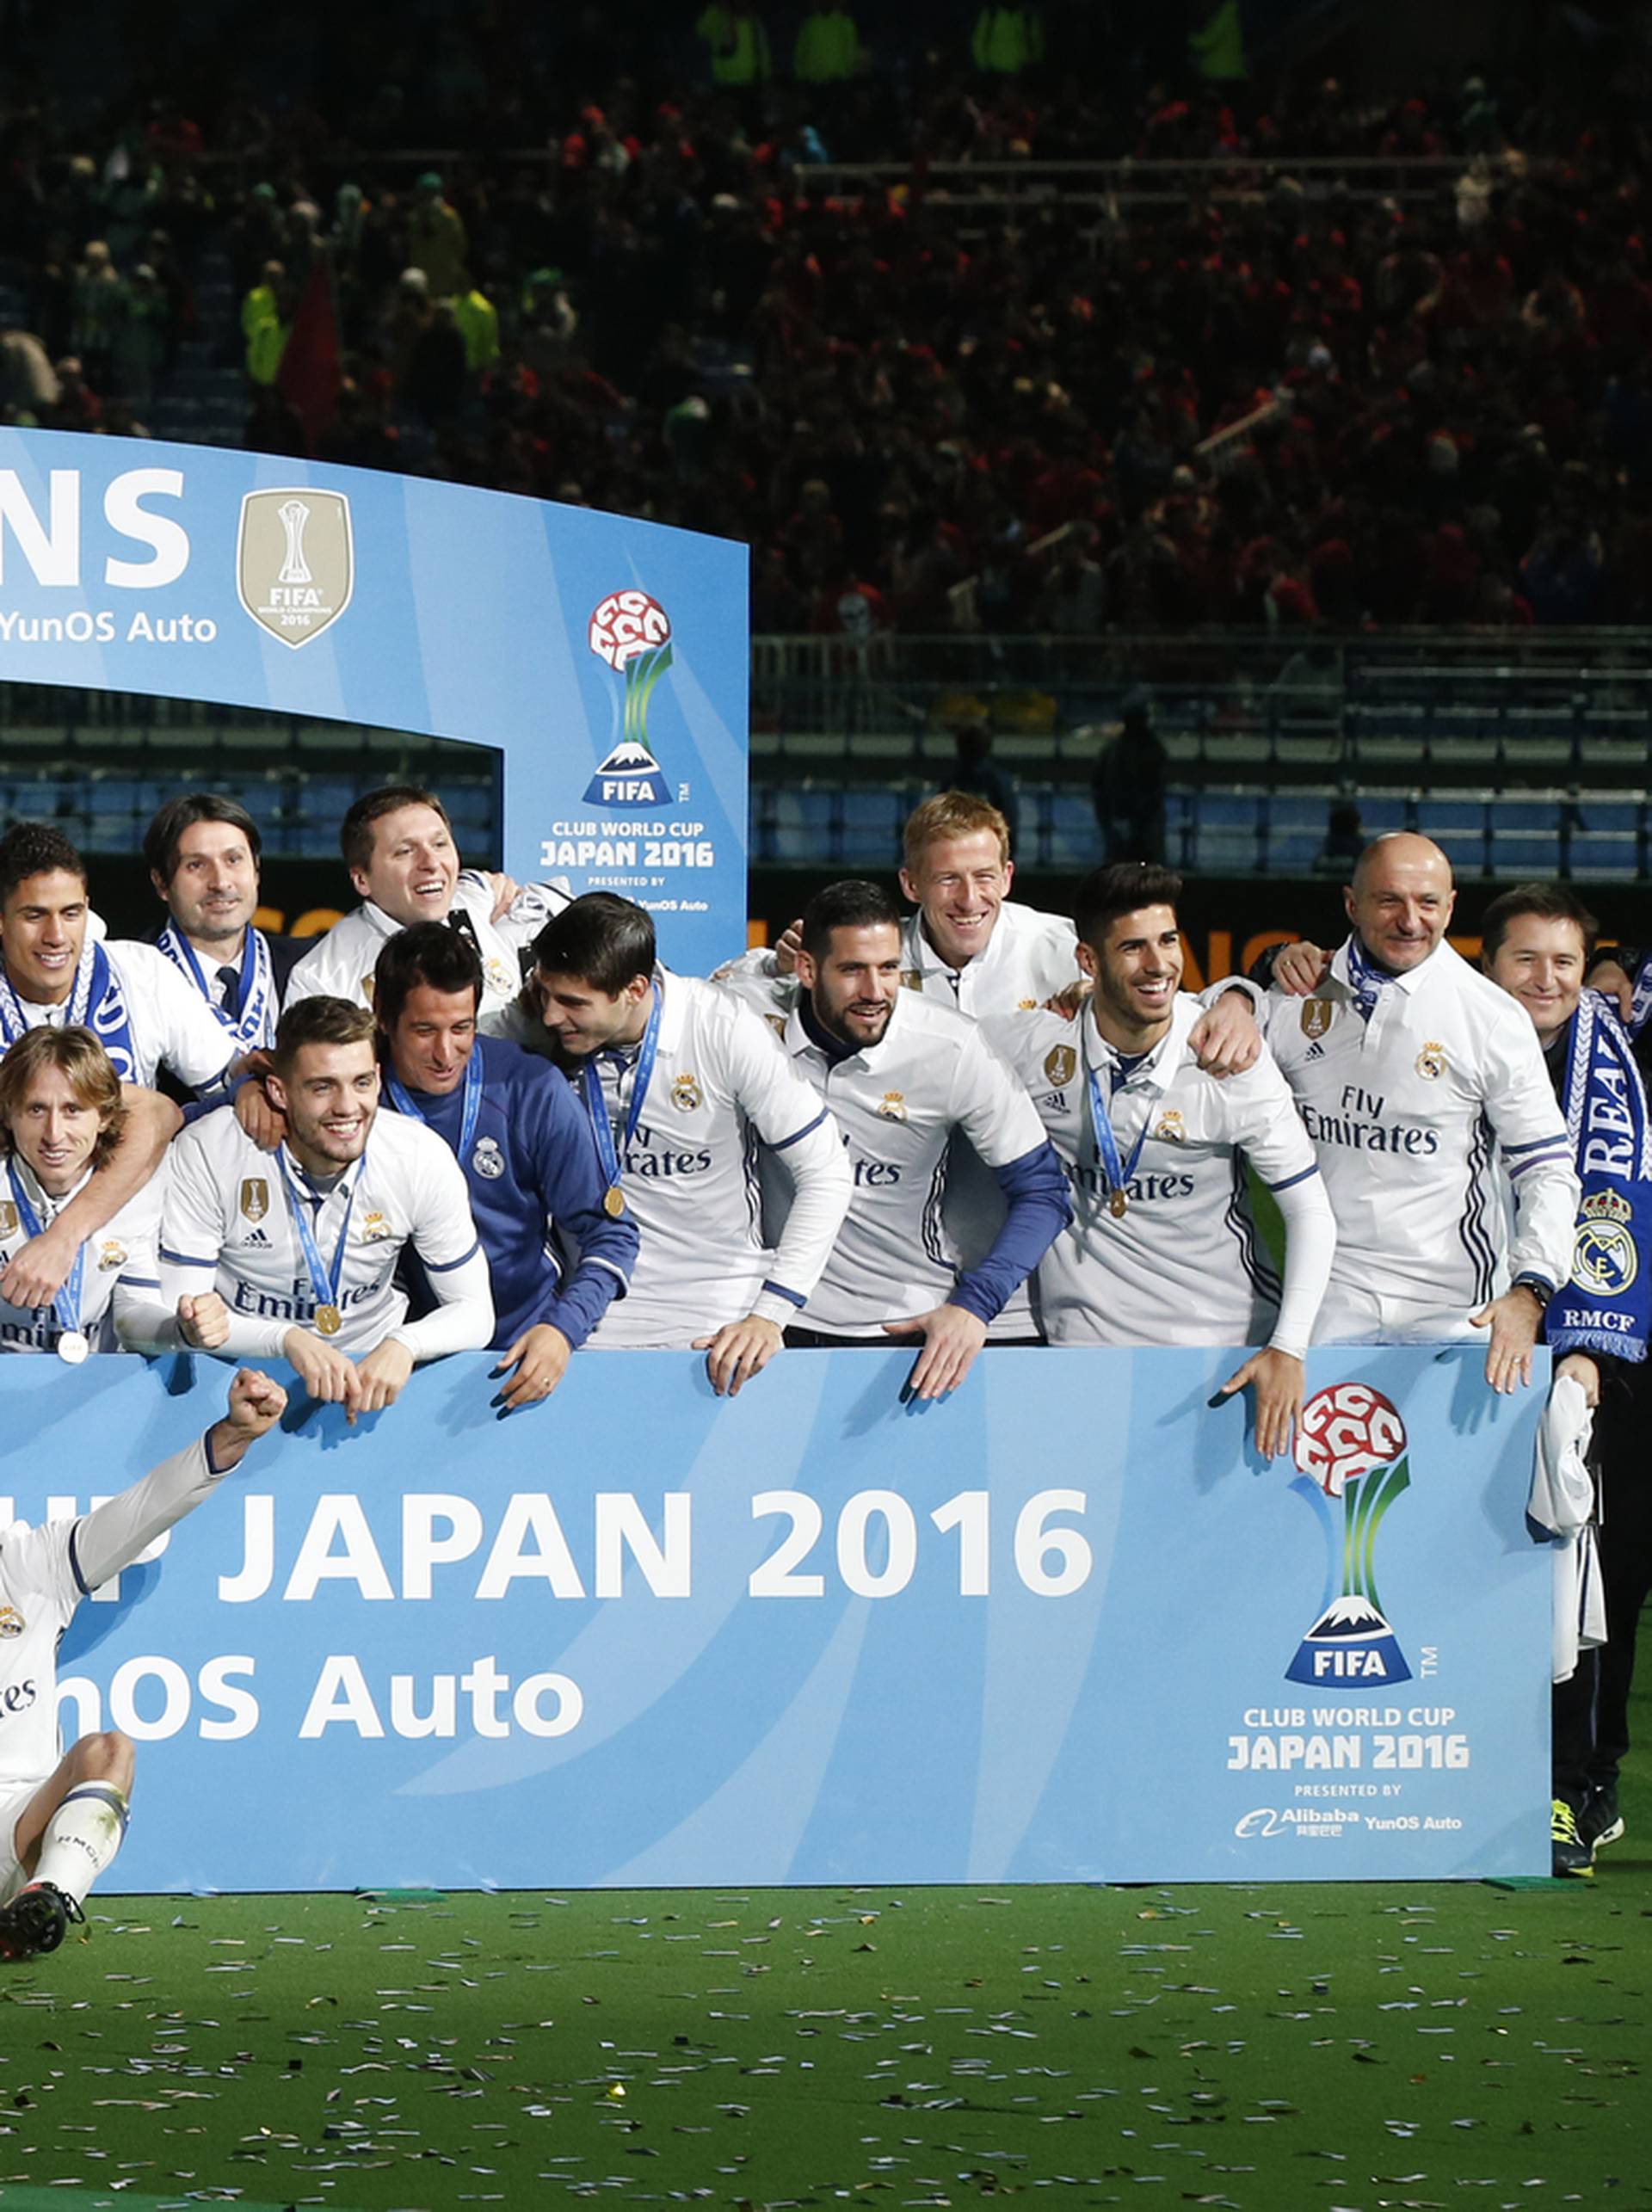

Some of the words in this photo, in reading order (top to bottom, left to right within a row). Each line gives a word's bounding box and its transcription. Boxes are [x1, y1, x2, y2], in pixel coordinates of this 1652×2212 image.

[270, 588, 320, 606] FIFA
[0, 612, 115, 643] YunOS
[127, 612, 217, 643] Auto
[280, 615, 311, 625] 2016
[602, 780, 656, 801] FIFA
[552, 822, 597, 837] CLUB
[601, 823, 666, 837] WORLD
[669, 823, 704, 837] CUP
[539, 841, 637, 867] JAPAN
[644, 841, 714, 867] 2016
[588, 877, 647, 887] PRESENTED
[650, 877, 665, 887] BY
[680, 900, 708, 911] Auto
[1341, 1085, 1384, 1118] Fly
[1302, 1105, 1439, 1155] Emirates
[625, 1149, 712, 1177] rates
[1563, 1309, 1636, 1332] RMCF
[218, 1493, 692, 1603] JAPAN
[749, 1488, 1094, 1599] 2016
[1313, 1650, 1388, 1677] FIFA
[56, 1654, 259, 1741] nOS
[298, 1654, 584, 1740] Auto
[1243, 1708, 1306, 1728] CLUB
[1312, 1708, 1402, 1728] WORLD
[1408, 1708, 1456, 1728] CUP
[1227, 1735, 1360, 1770] JAPAN
[1372, 1734, 1470, 1769] 2016
[1294, 1784, 1378, 1797] PRESENTED
[1383, 1784, 1402, 1797] BY
[1280, 1808, 1359, 1823] Alibaba
[1365, 1815, 1420, 1831] YunOS
[1423, 1815, 1463, 1831] Auto
